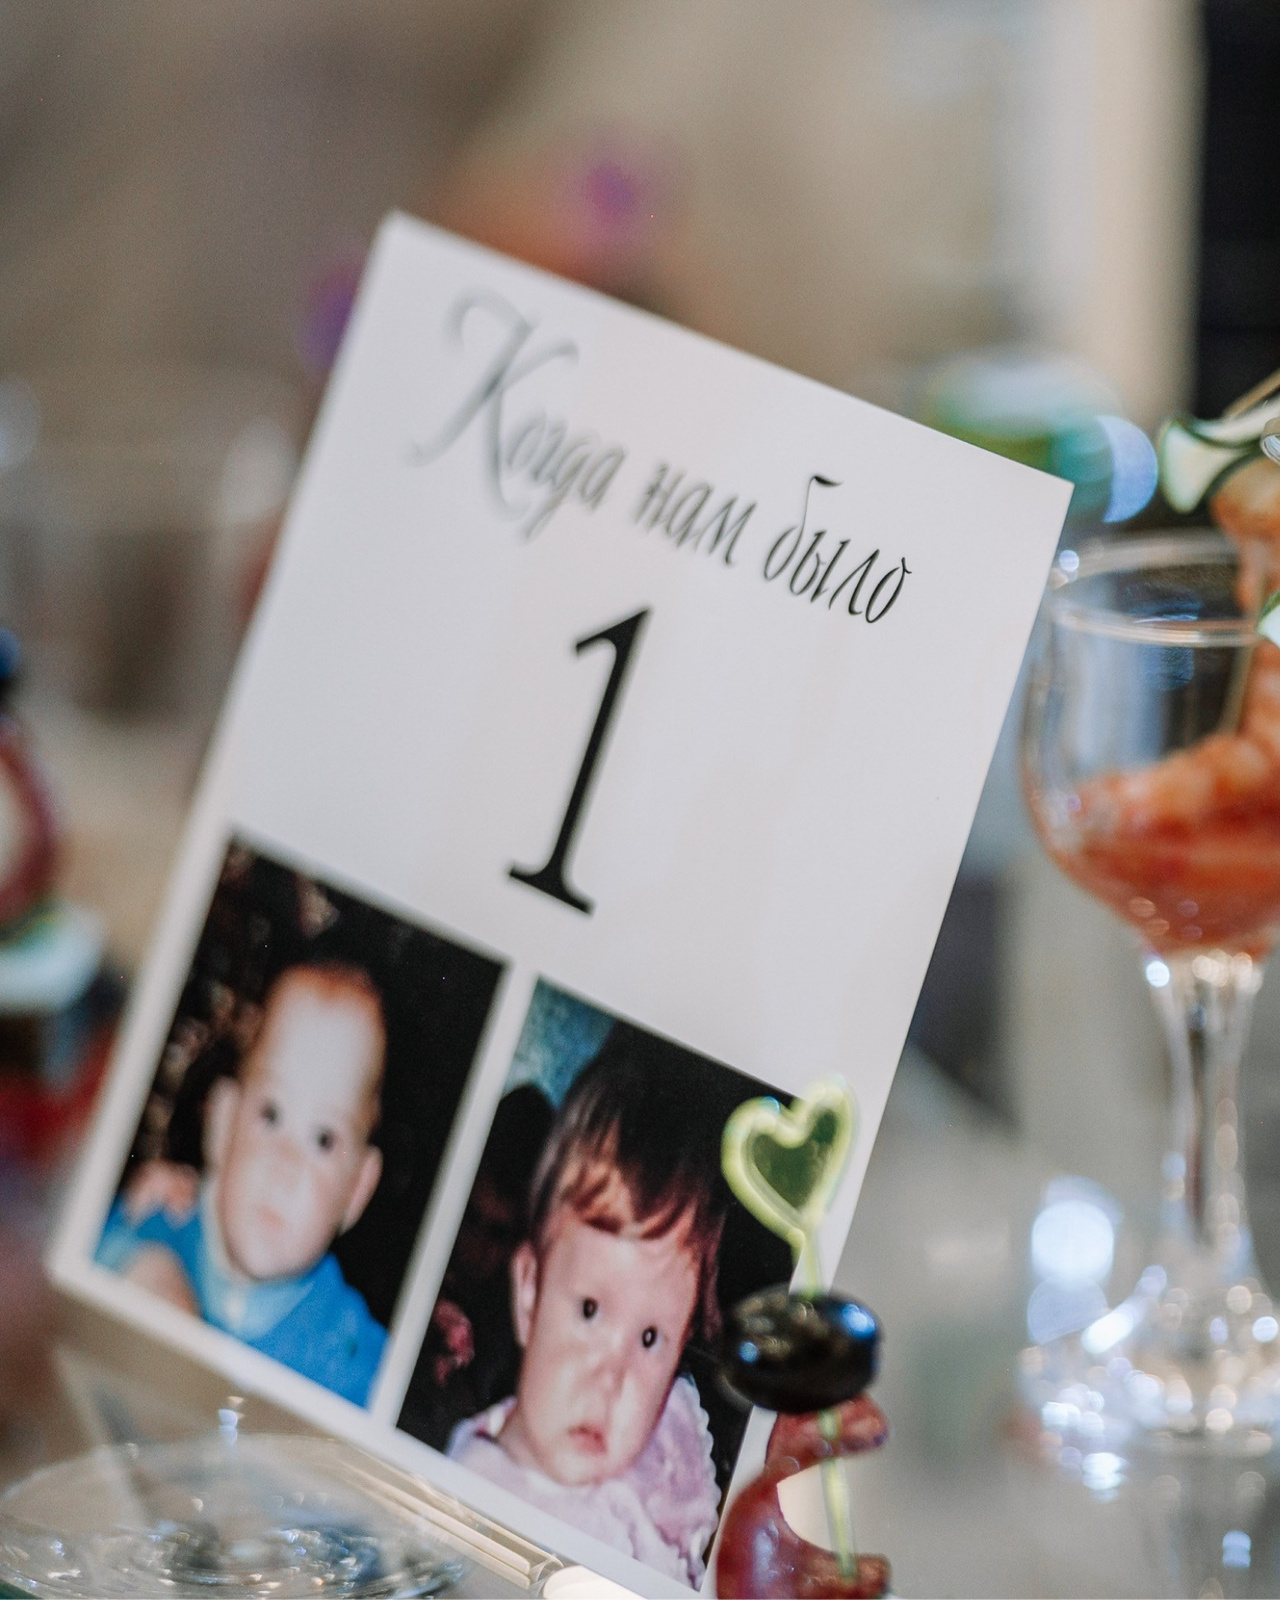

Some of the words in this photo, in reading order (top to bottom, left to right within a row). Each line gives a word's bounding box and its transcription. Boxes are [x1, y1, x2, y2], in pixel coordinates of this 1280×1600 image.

[405, 290, 627, 542] Когда
[635, 461, 757, 567] нам
[763, 473, 912, 624] было
[505, 604, 653, 917] 1
